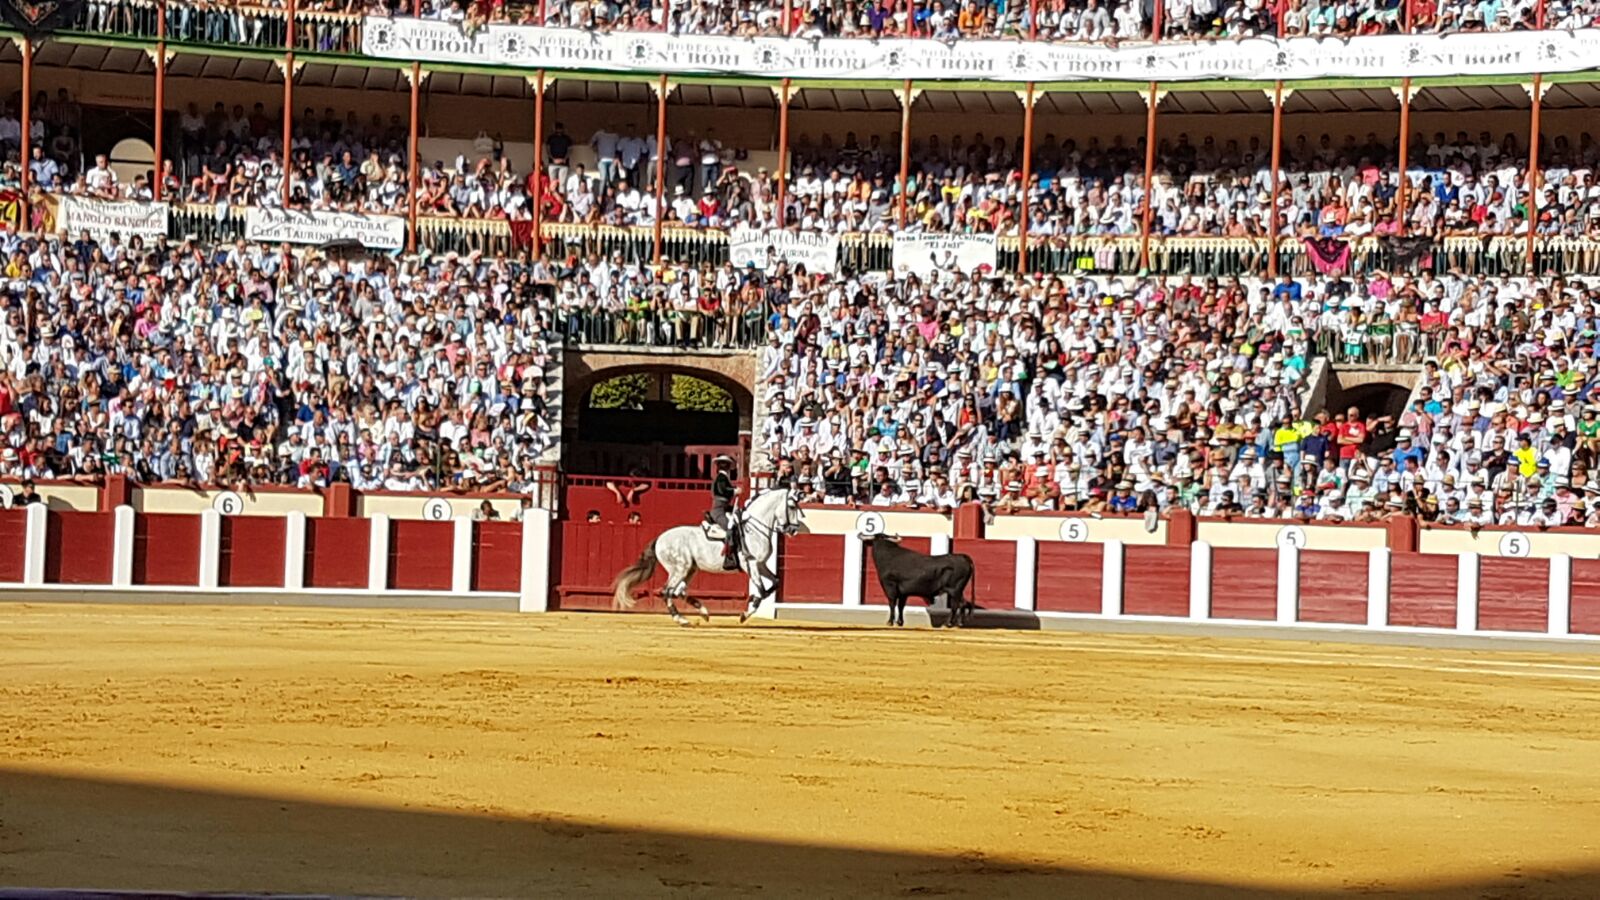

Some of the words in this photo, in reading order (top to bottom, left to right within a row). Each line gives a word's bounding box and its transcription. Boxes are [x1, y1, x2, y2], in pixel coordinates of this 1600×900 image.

[399, 37, 484, 54] NUBORI
[528, 45, 612, 61] NUBORI
[656, 51, 739, 66] NUBORI
[783, 56, 866, 70] NUBORI
[1036, 59, 1121, 72] NUBORI
[333, 216, 390, 232] CULTURAL
[251, 224, 281, 238] CLUB
[284, 226, 333, 241] TAURINO
[222, 497, 234, 514] 6
[432, 504, 442, 520] 6
[865, 517, 876, 533] 5
[1068, 523, 1080, 539] 5
[1509, 538, 1521, 555] 5
